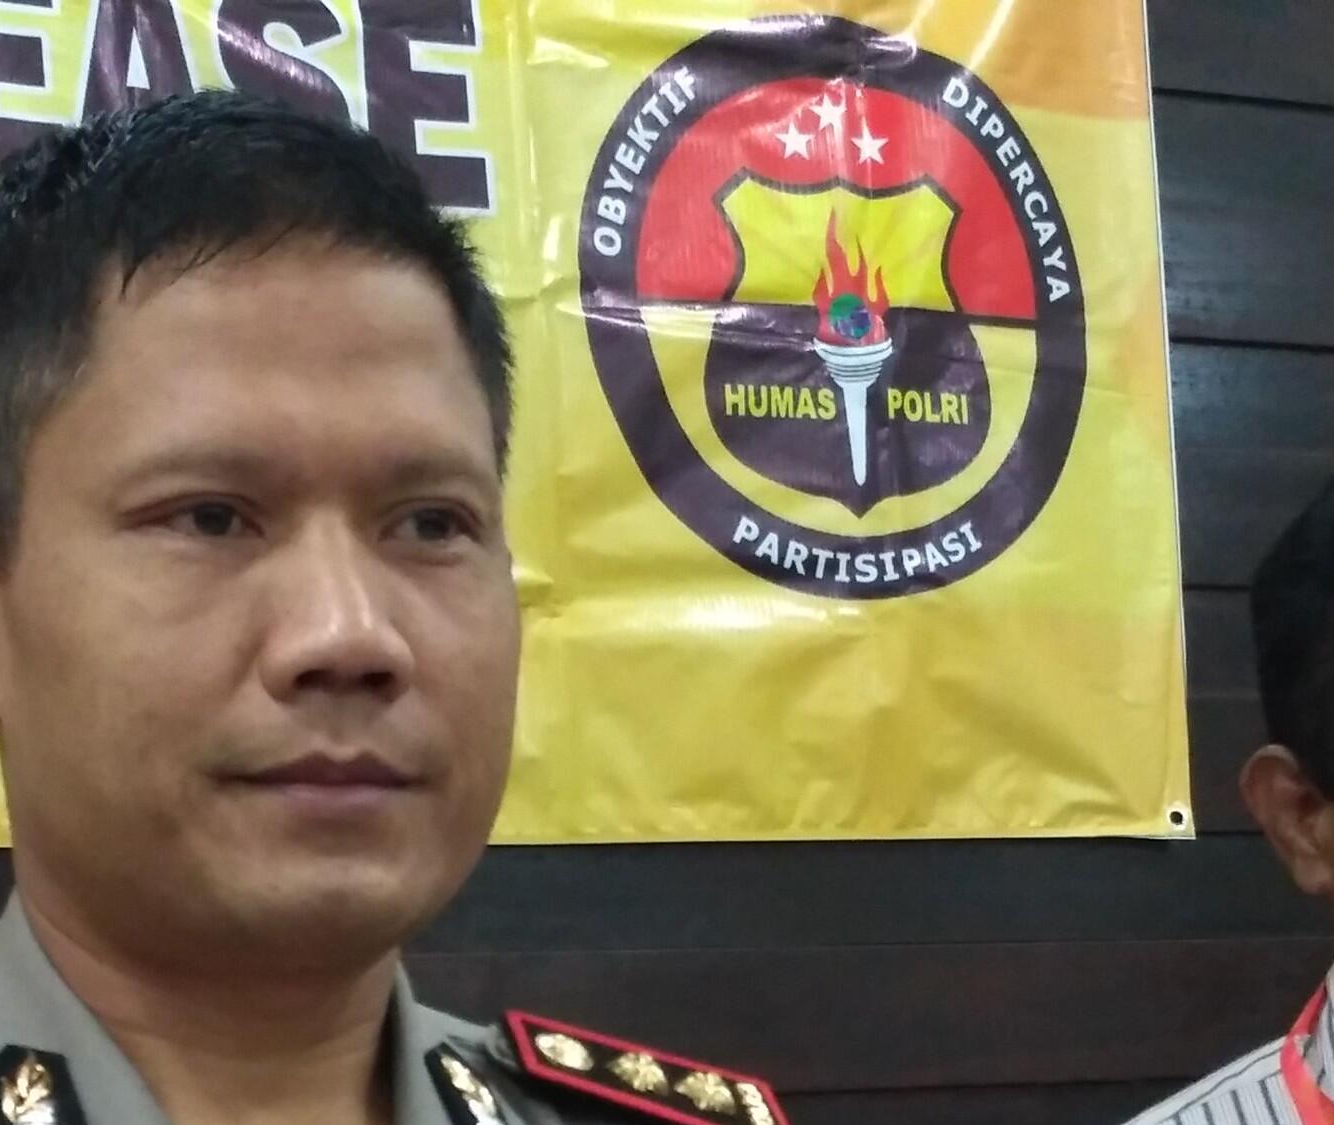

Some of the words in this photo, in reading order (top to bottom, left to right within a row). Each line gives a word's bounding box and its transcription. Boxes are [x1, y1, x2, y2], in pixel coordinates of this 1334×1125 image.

[593, 68, 698, 257] OBYEKTIF
[942, 77, 1071, 302] DIPERCAYA
[724, 383, 837, 420] HUMAS
[887, 388, 969, 425] POLRI
[733, 516, 983, 583] PARTISIPASI
